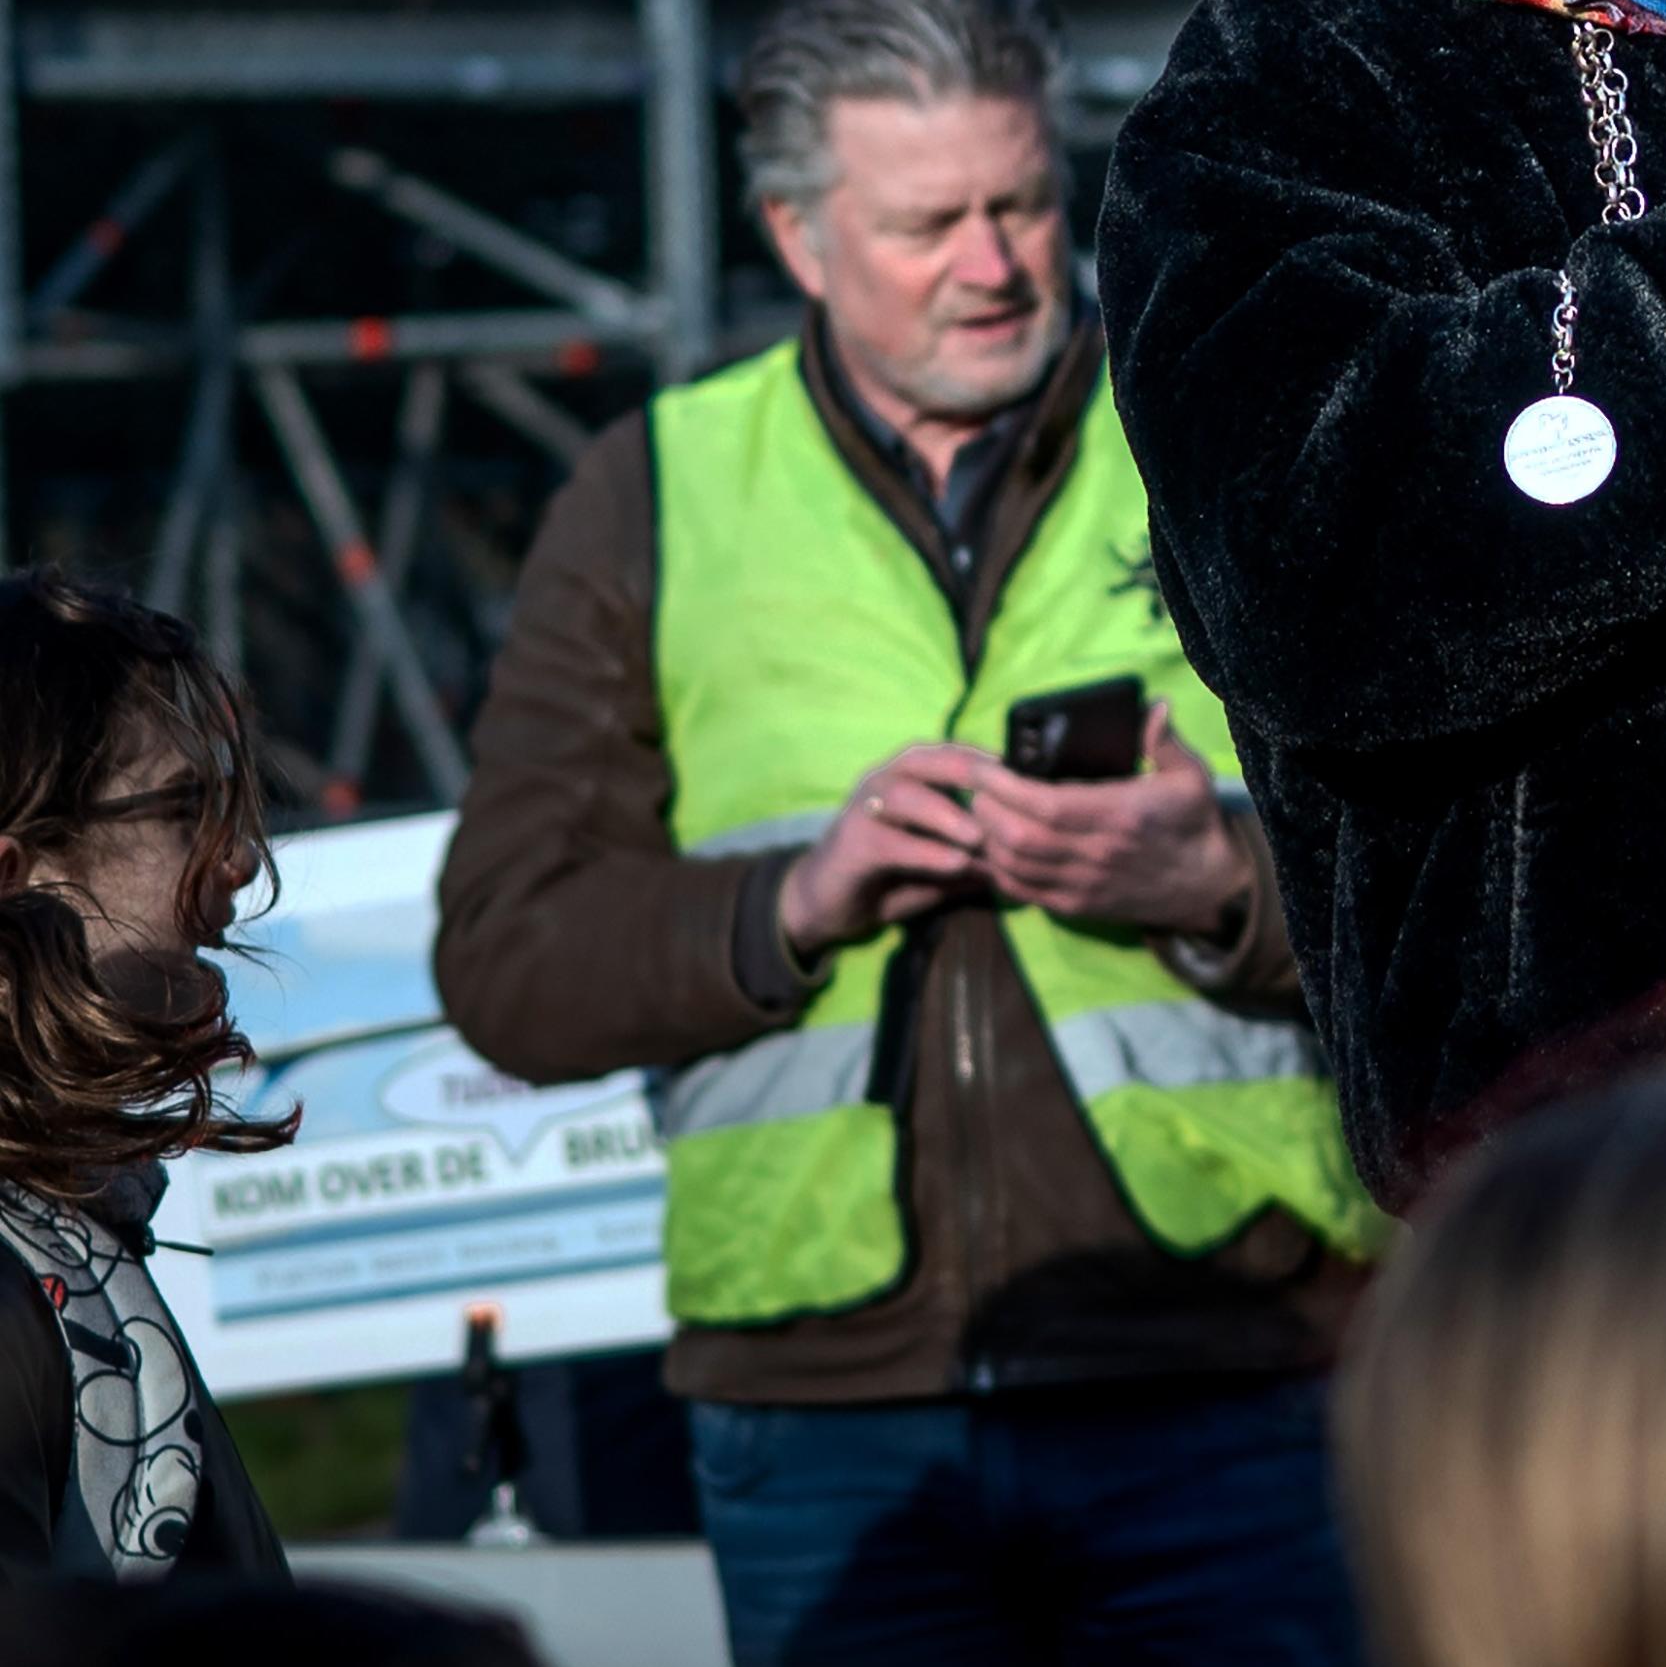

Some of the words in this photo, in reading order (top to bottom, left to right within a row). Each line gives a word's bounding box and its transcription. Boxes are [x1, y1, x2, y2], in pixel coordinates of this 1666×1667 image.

[212, 1164, 310, 1219] KOM
[321, 1148, 425, 1206] OVER
[435, 1139, 487, 1186] DE
[563, 1124, 666, 1171] BRU
